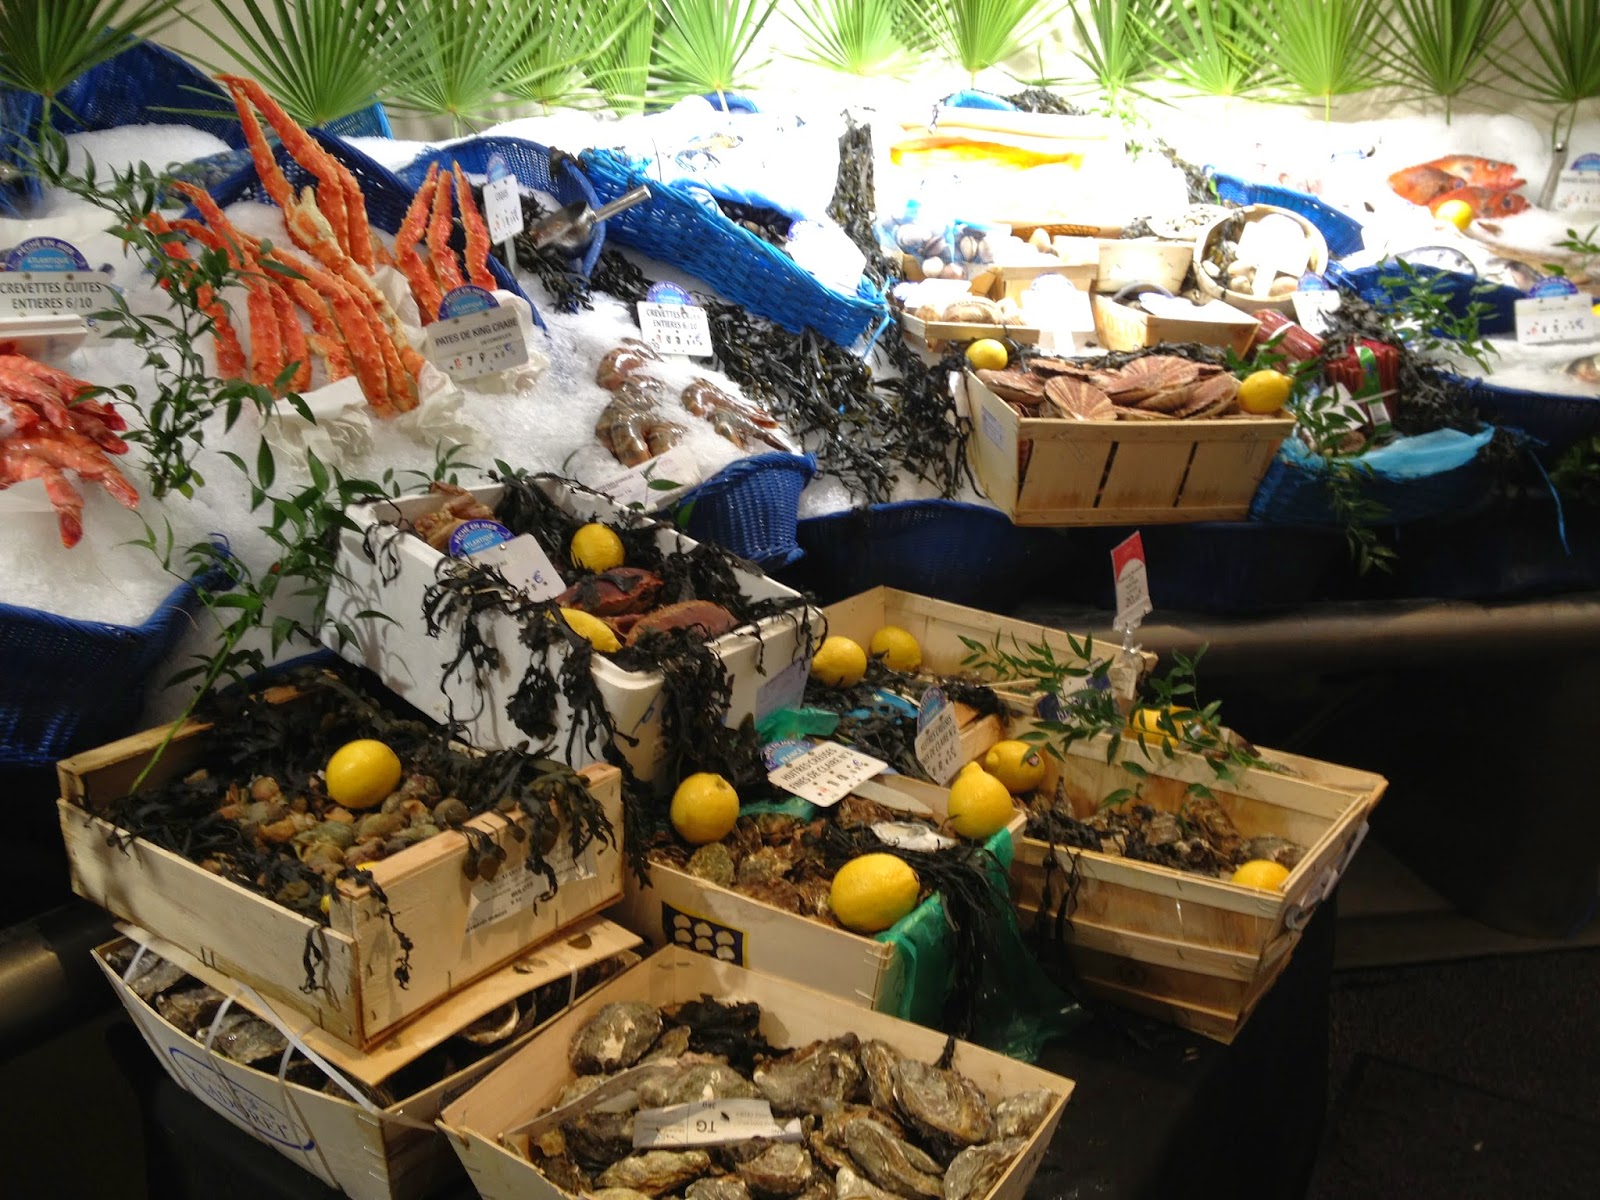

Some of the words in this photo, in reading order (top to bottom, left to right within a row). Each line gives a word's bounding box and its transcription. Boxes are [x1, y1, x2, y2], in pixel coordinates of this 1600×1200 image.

[0, 282, 62, 295] CREVETTES
[63, 281, 102, 293] CUITES
[12, 297, 64, 309] ENTIERES
[65, 296, 93, 309] 6/10
[646, 308, 681, 319] CREVETTES
[653, 319, 681, 329] ENTIERES
[434, 333, 460, 347] PATES
[460, 329, 472, 341] DE
[472, 324, 492, 337] KING
[492, 317, 518, 332] CRABE
[469, 522, 480, 531] EN
[481, 522, 498, 531] MER
[781, 763, 811, 781] HUITRES
[806, 770, 821, 780] DE
[696, 1119, 717, 1134] TG
